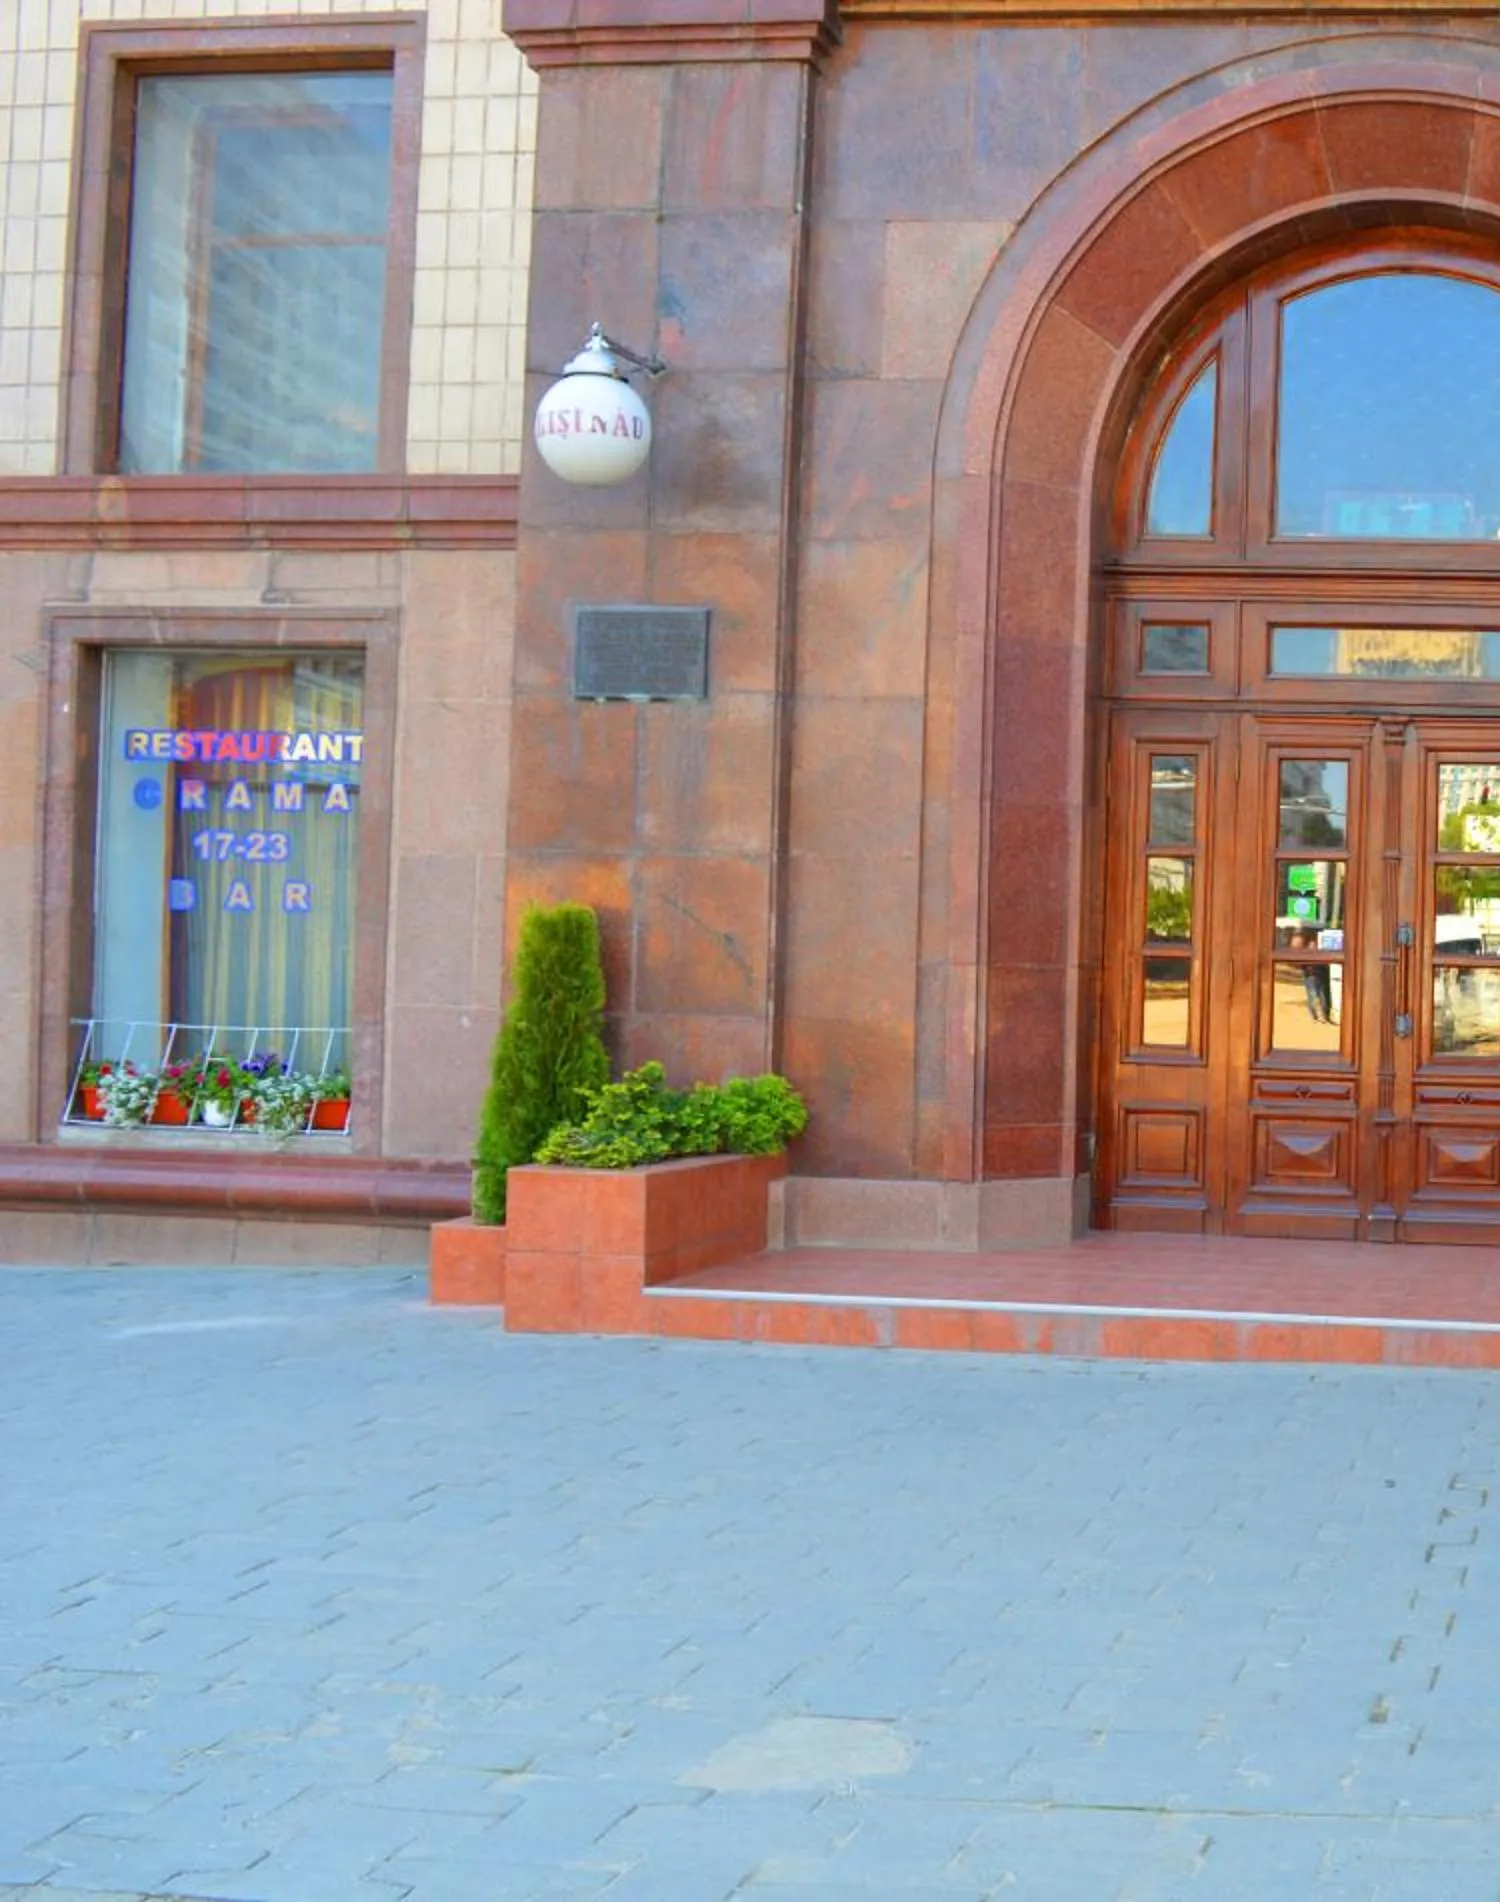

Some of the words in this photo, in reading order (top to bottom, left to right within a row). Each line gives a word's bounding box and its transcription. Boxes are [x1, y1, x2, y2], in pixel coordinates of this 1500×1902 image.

[126, 730, 364, 762] RESTAURANT
[193, 831, 290, 862] 17-23
[169, 880, 310, 912] BAR
